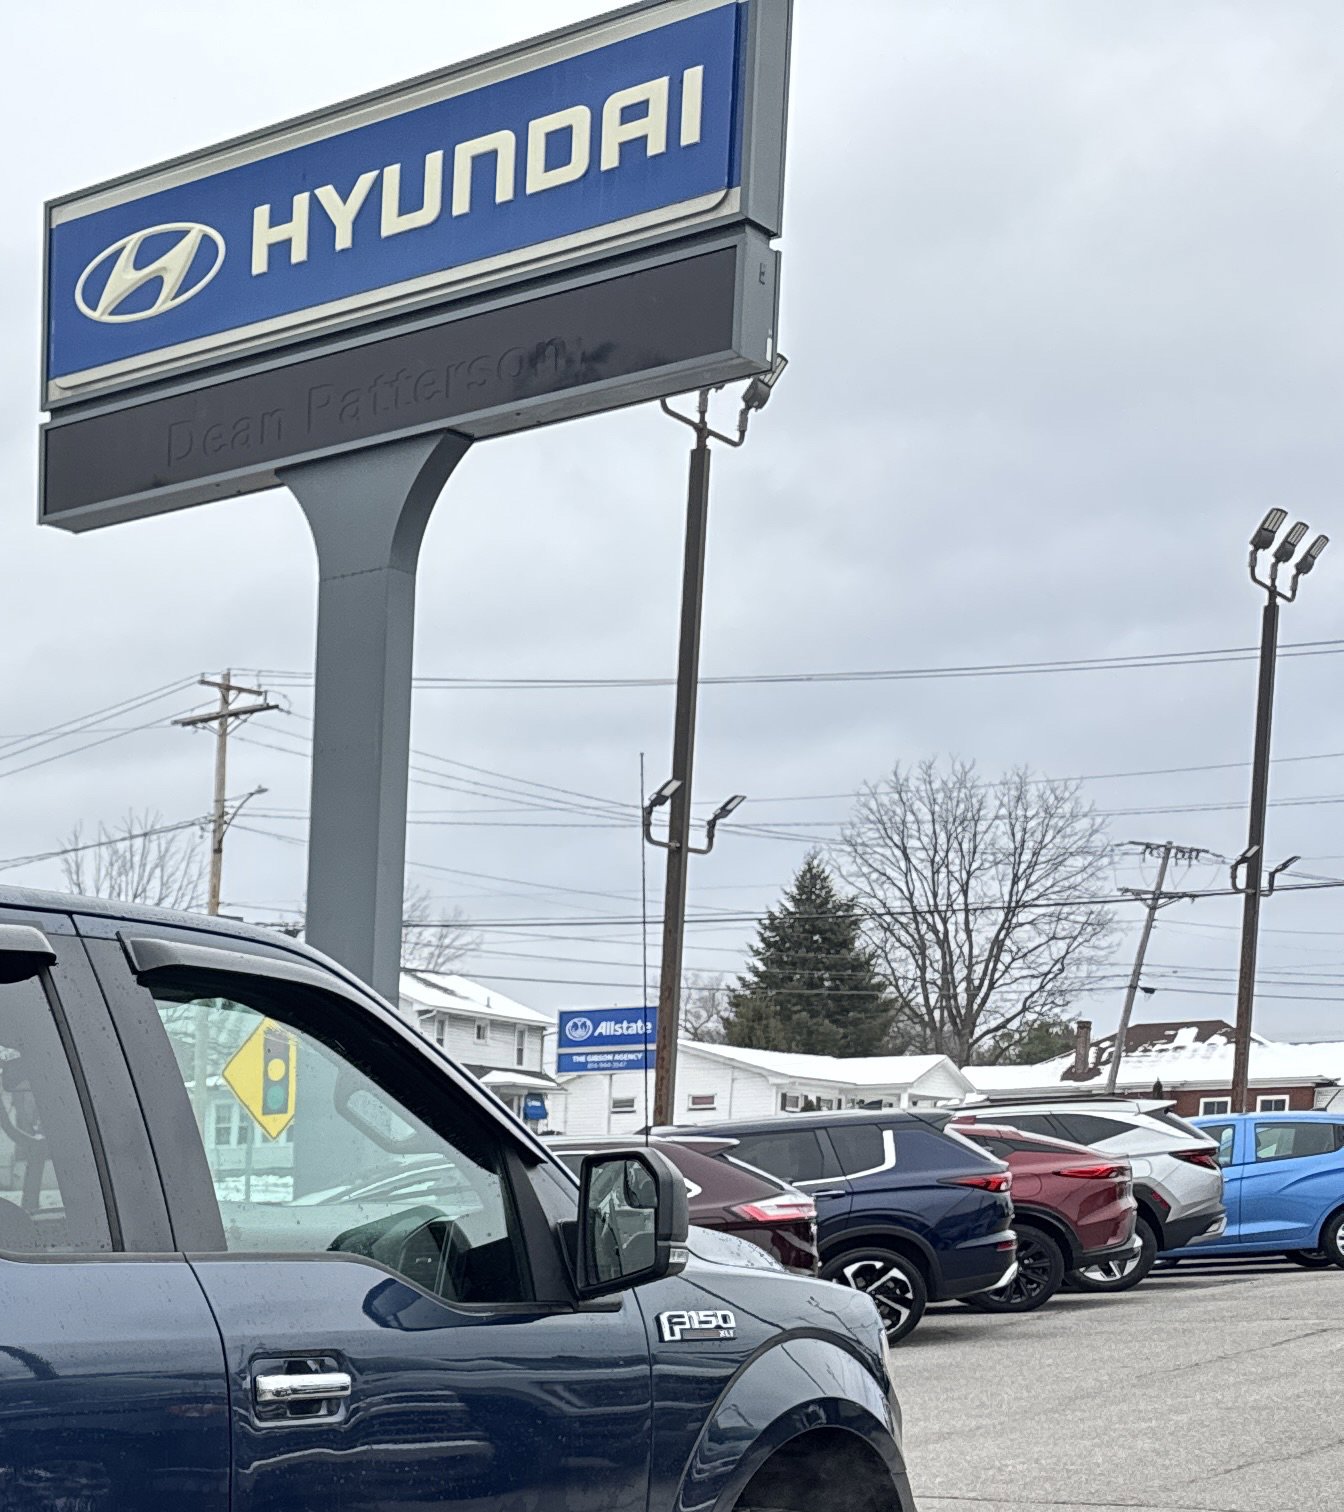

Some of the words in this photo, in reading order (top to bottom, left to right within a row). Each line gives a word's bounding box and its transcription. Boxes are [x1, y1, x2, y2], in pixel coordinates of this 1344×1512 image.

[250, 64, 705, 276] HYUNDAI
[165, 406, 285, 468] Dean
[307, 337, 568, 436] Patterson
[594, 1019, 652, 1036] Allstate
[719, 1329, 734, 1337] XLT
